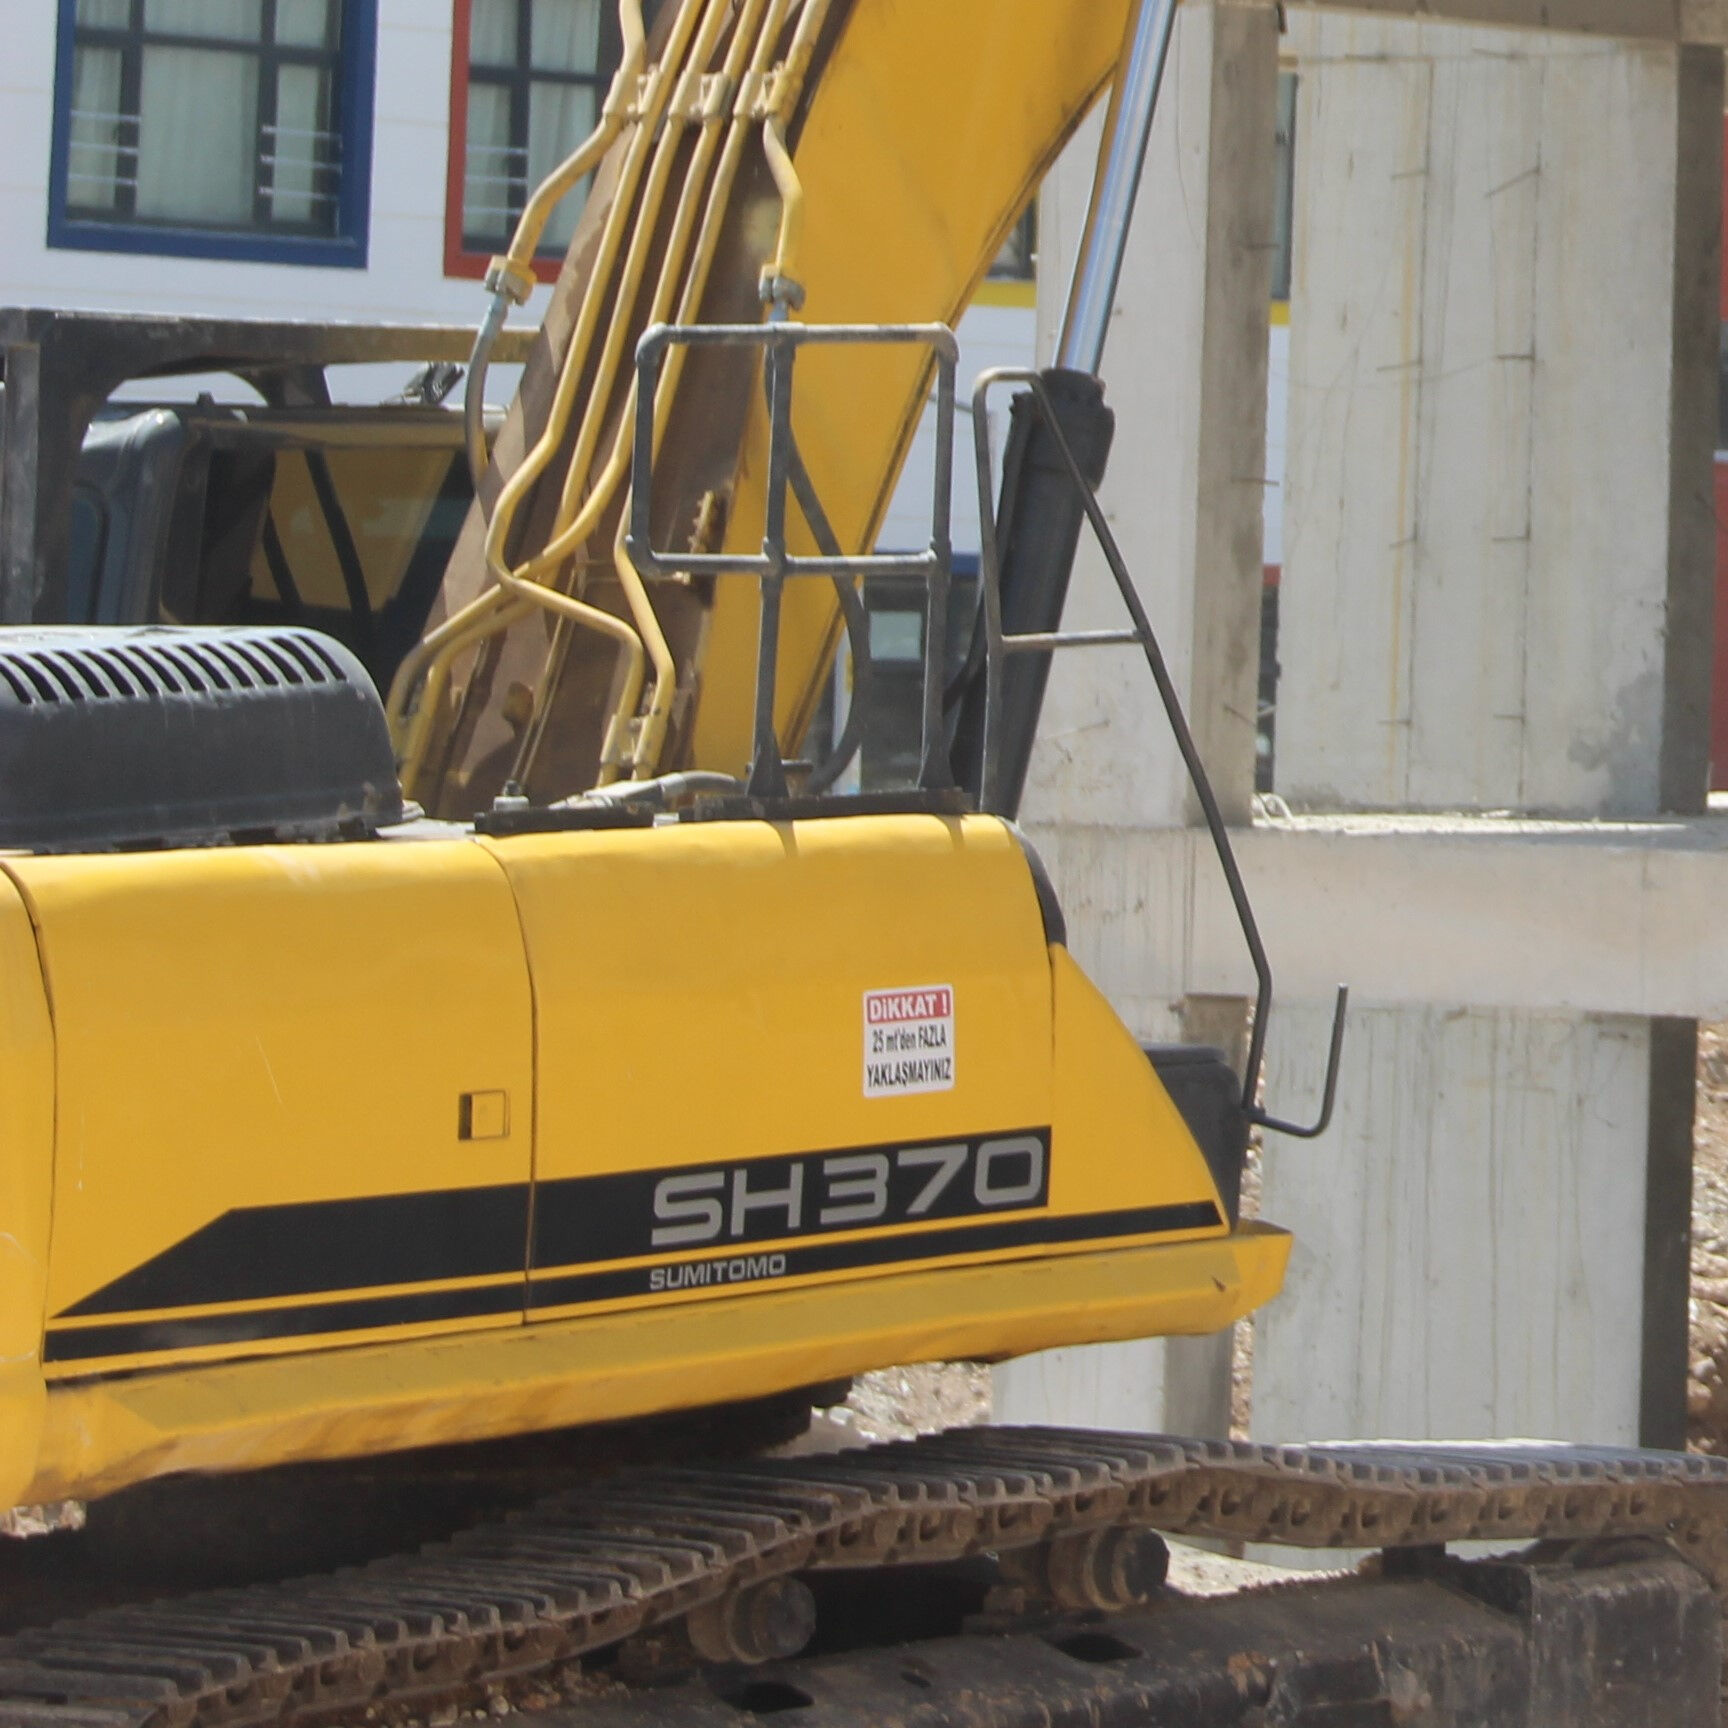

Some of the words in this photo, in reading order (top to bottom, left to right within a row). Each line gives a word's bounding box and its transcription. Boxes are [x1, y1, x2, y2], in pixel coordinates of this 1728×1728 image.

[872, 1029, 884, 1053] 25
[919, 1023, 947, 1048] FAZLA
[867, 1057, 952, 1088] YAKLAŞMAYINIZ
[650, 1253, 787, 1292] SUMITOMO
